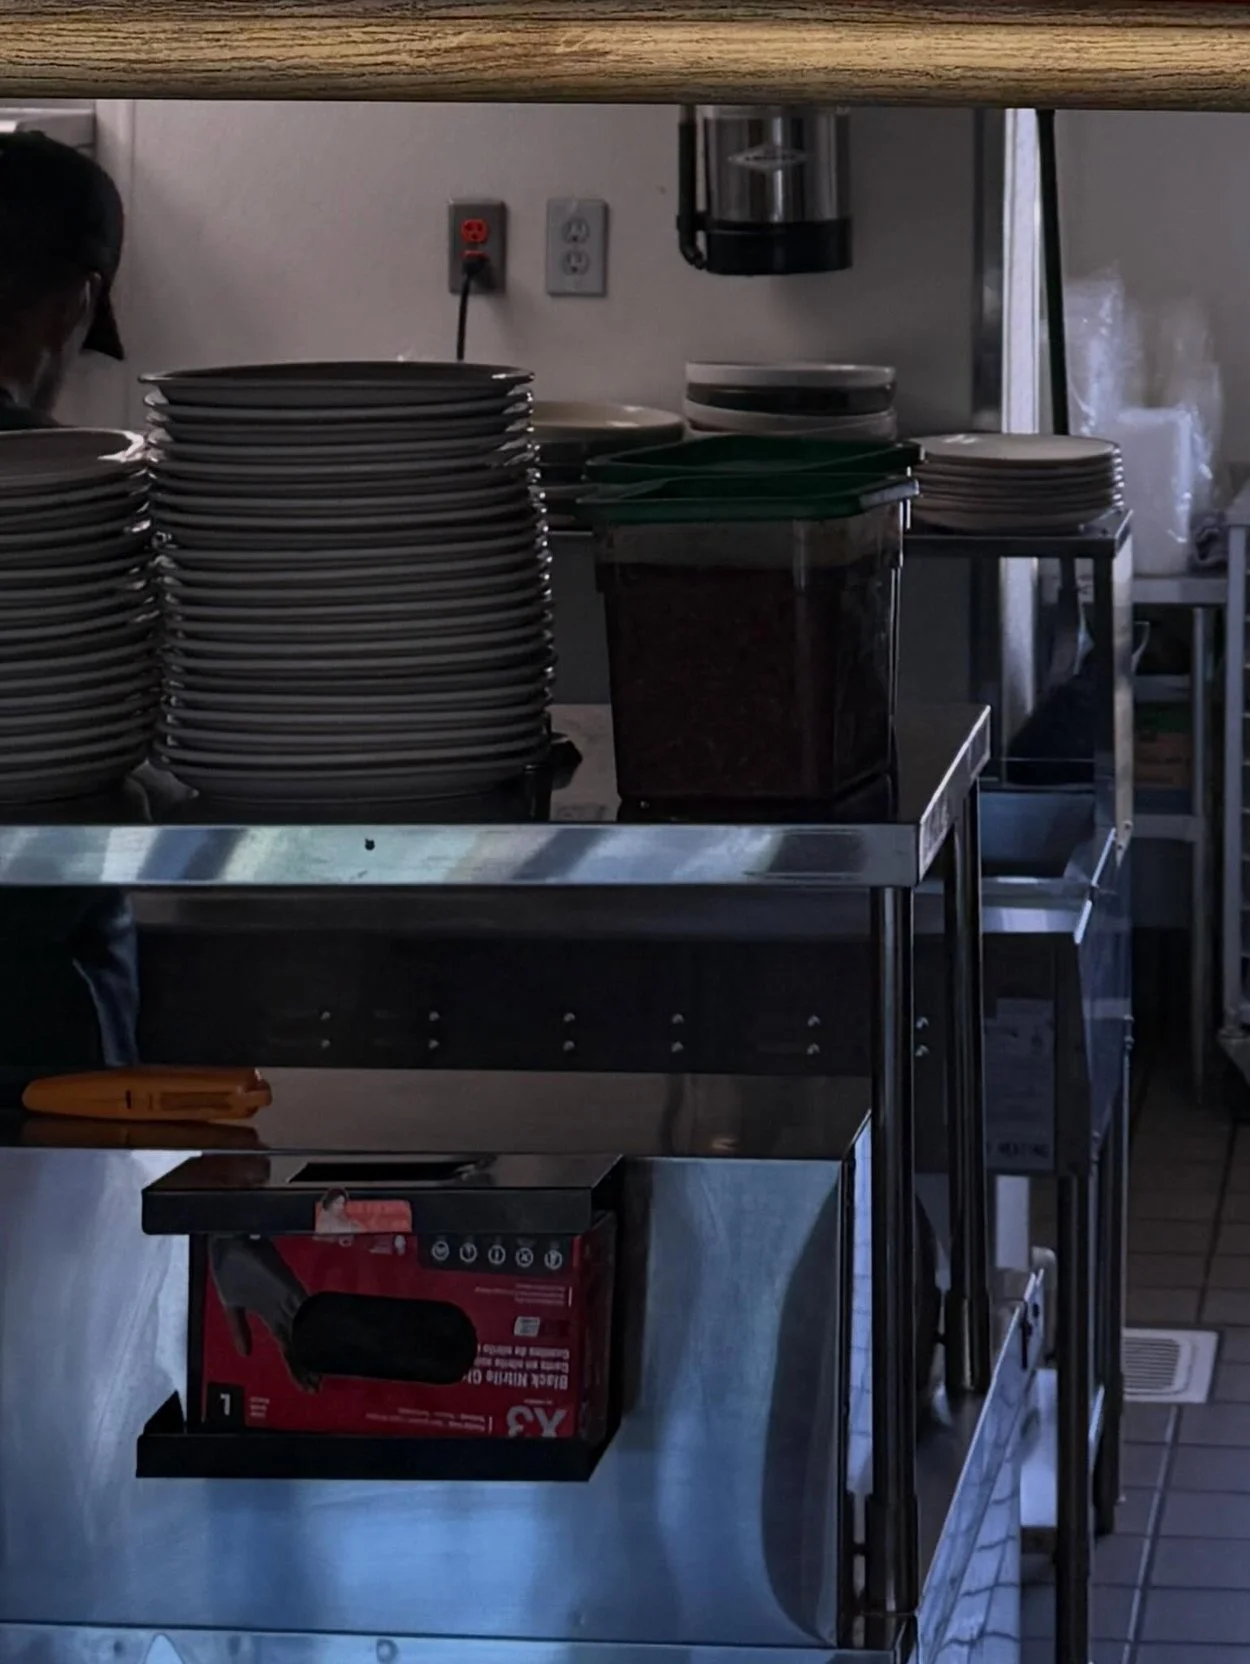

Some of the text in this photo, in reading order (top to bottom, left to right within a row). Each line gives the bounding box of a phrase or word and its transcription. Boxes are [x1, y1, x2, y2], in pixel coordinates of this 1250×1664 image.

[486, 1369, 527, 1388] Nitrile
[530, 1373, 568, 1390] Black
[219, 1393, 231, 1417] L
